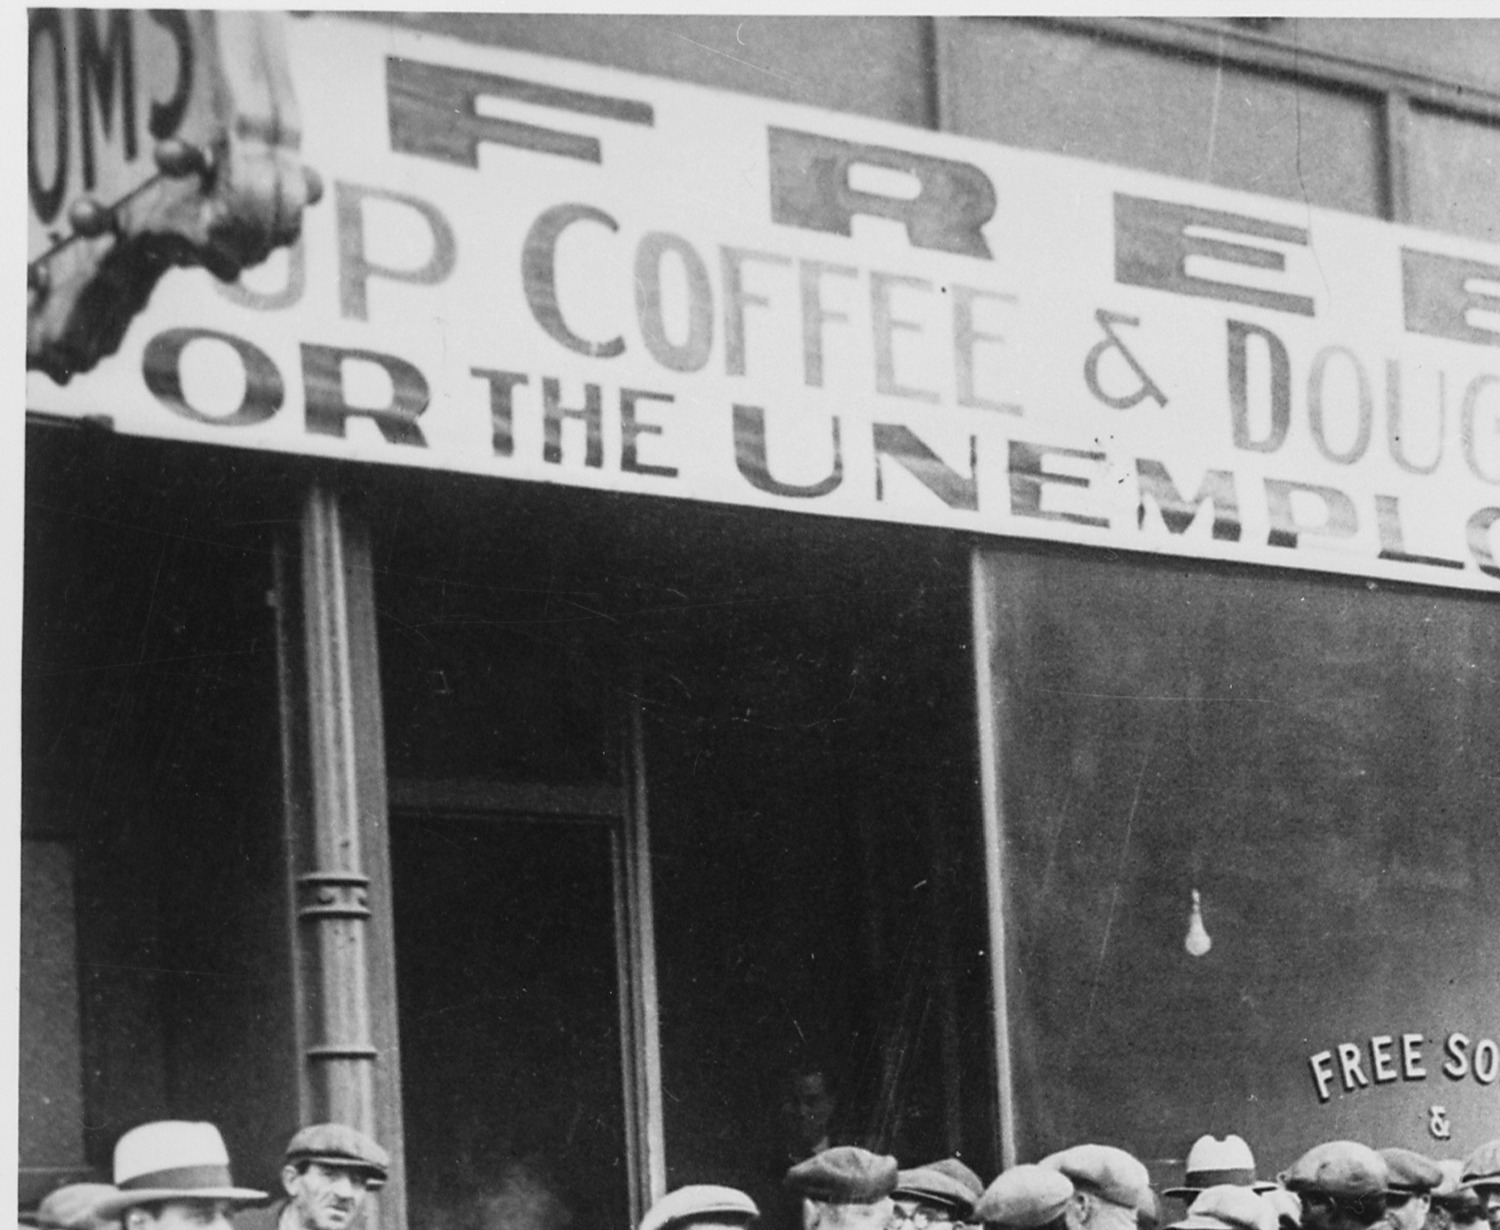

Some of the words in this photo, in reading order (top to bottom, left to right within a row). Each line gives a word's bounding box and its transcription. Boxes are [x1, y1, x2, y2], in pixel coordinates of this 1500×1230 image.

[520, 202, 1025, 417] COFFEE
[1083, 307, 1169, 409] &
[470, 366, 679, 478] THE
[1308, 1033, 1427, 1101] FREE
[1429, 1105, 1450, 1137] &
